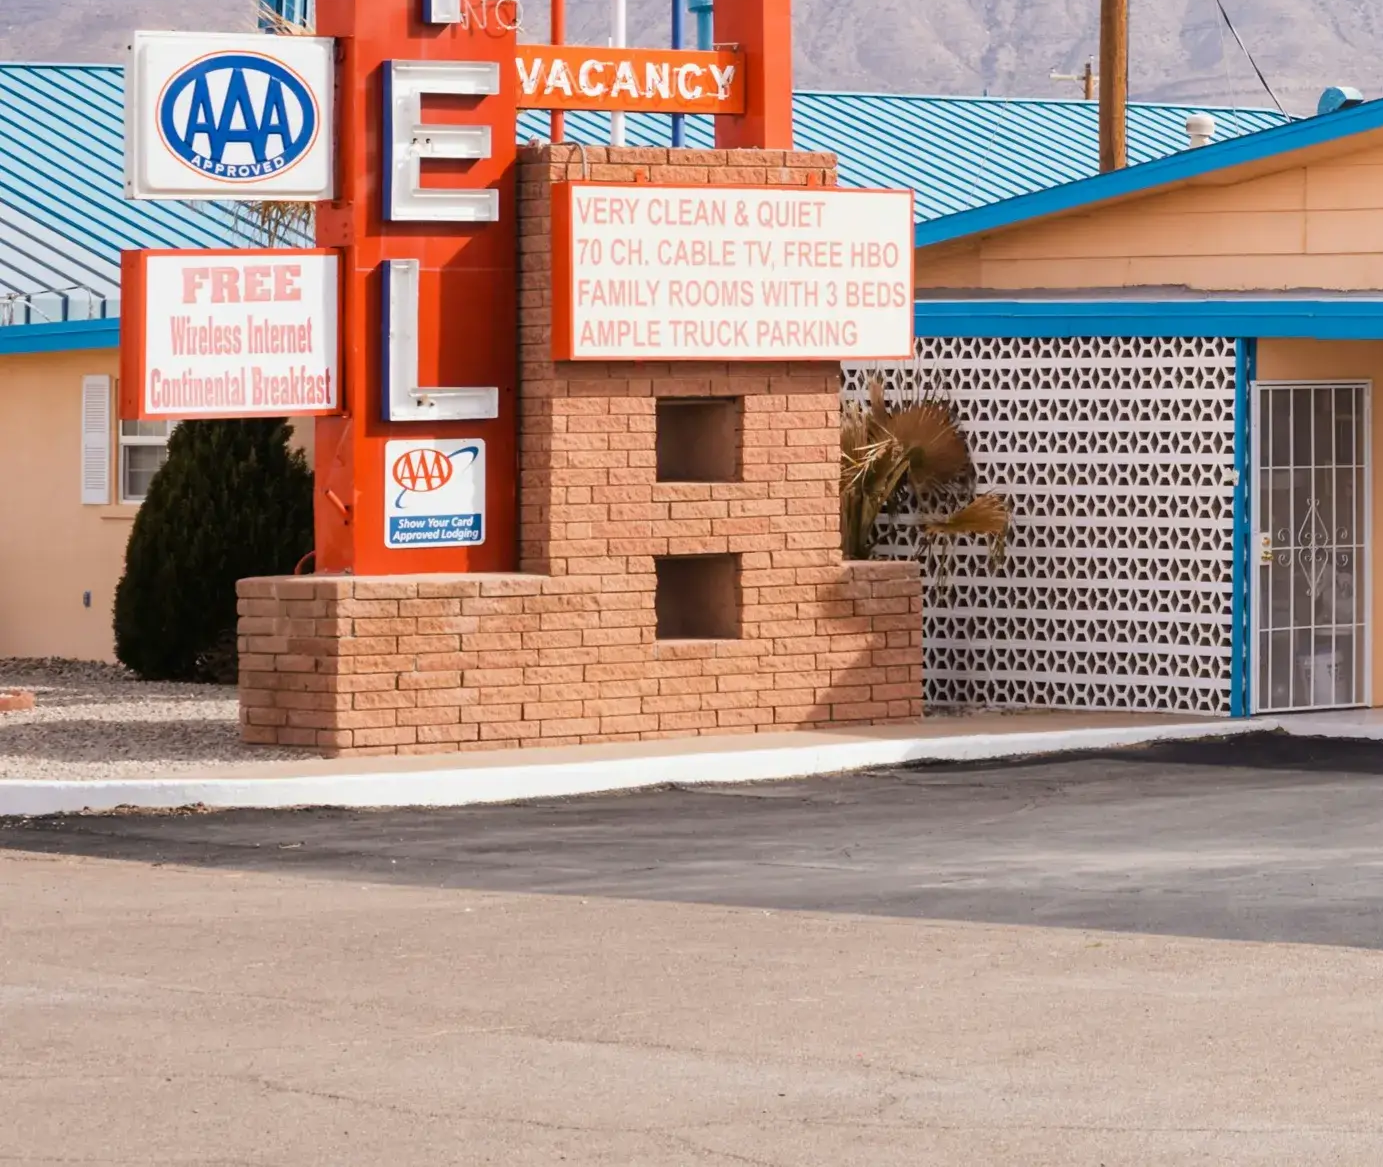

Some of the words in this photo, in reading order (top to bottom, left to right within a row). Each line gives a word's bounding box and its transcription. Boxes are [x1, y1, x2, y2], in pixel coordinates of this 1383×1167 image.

[516, 57, 736, 99] VACANCY
[184, 68, 293, 163] AAA
[191, 155, 286, 178] APPROVED
[577, 197, 640, 225] VERY
[648, 198, 726, 226] CLEAN
[734, 201, 749, 227] &
[757, 201, 825, 229] QUIET
[577, 239, 602, 266] 70
[610, 239, 649, 266] CH.
[657, 240, 735, 267] CABLE
[744, 241, 775, 271] TV,
[784, 241, 842, 268] FREE
[851, 242, 898, 269] HBO
[181, 264, 300, 304] FREE
[577, 279, 660, 307] FAMILY
[669, 280, 754, 307] ROOMS
[761, 280, 818, 307] WITH
[826, 281, 837, 307] 3
[845, 281, 906, 308] BEDS
[170, 316, 242, 355] Wireless
[247, 315, 313, 354] Internet
[580, 320, 661, 347] AMPLE
[669, 320, 748, 347] TRUCK
[756, 320, 858, 347] PARKING
[150, 367, 246, 409] Continental
[252, 366, 331, 407] Breakfast
[398, 449, 447, 491] AAA
[392, 530, 440, 542] Approved
[441, 528, 479, 540] Lodging
[398, 519, 425, 529] Show
[428, 518, 449, 528] Your
[451, 516, 474, 527] Card
